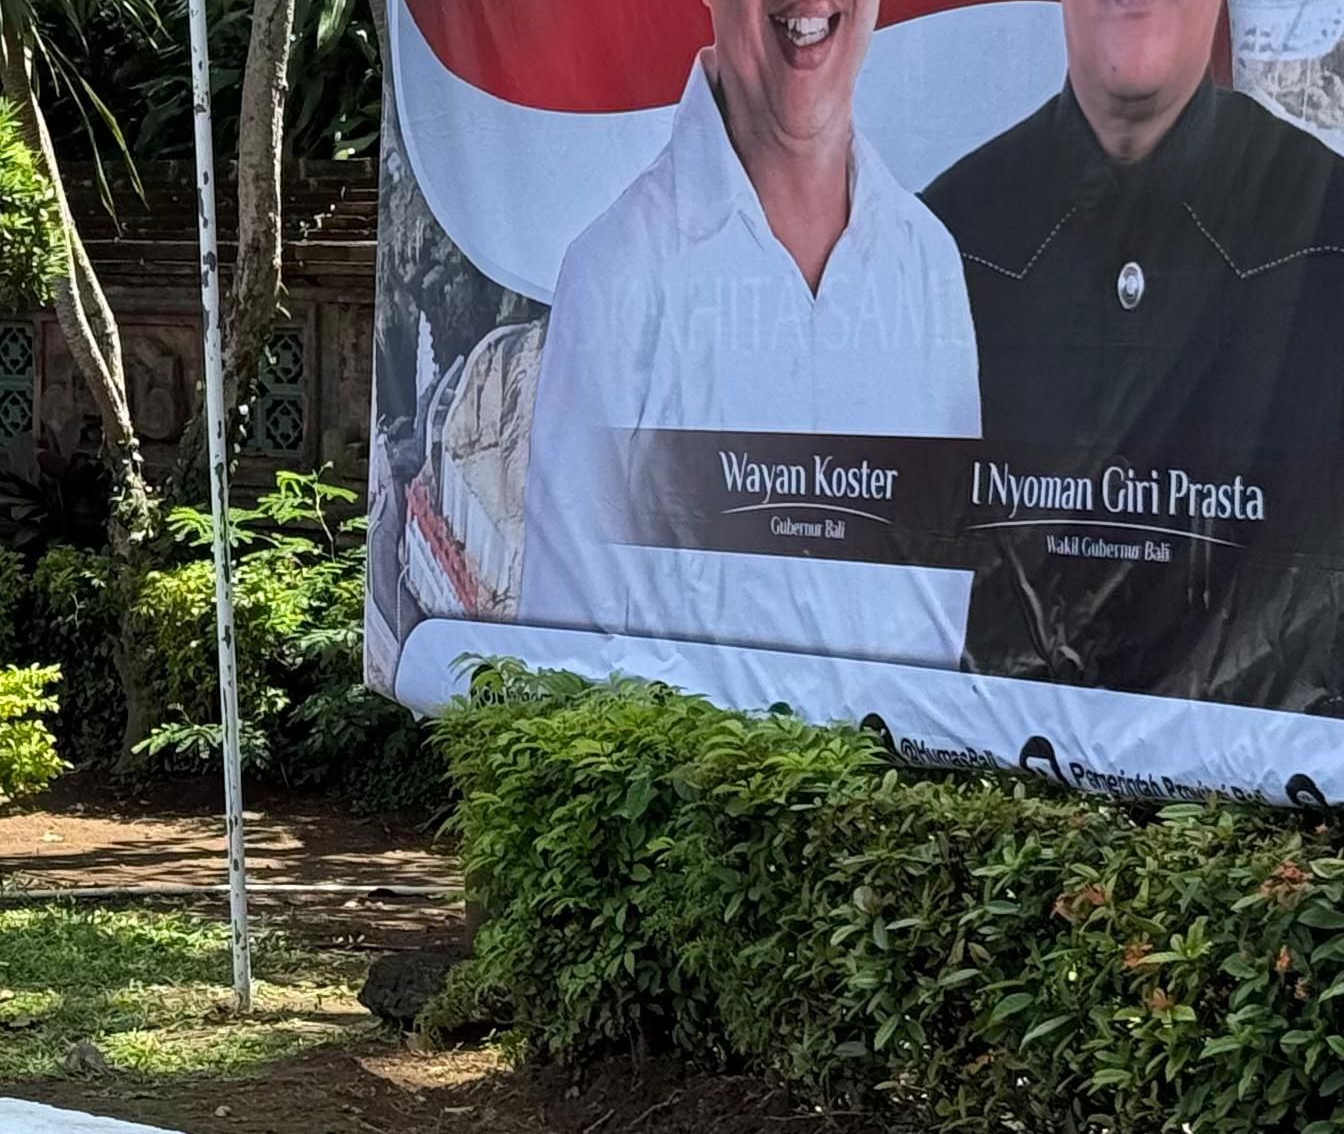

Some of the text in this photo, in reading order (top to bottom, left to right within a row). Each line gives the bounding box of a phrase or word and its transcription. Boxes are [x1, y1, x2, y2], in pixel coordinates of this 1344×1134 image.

[717, 449, 900, 505] Wayan Koster
[971, 463, 1266, 522] I Nyoman Giri Prasta
[770, 516, 846, 539] Gubernur Bali
[1046, 534, 1171, 563] Wakil Gubernur Bali
